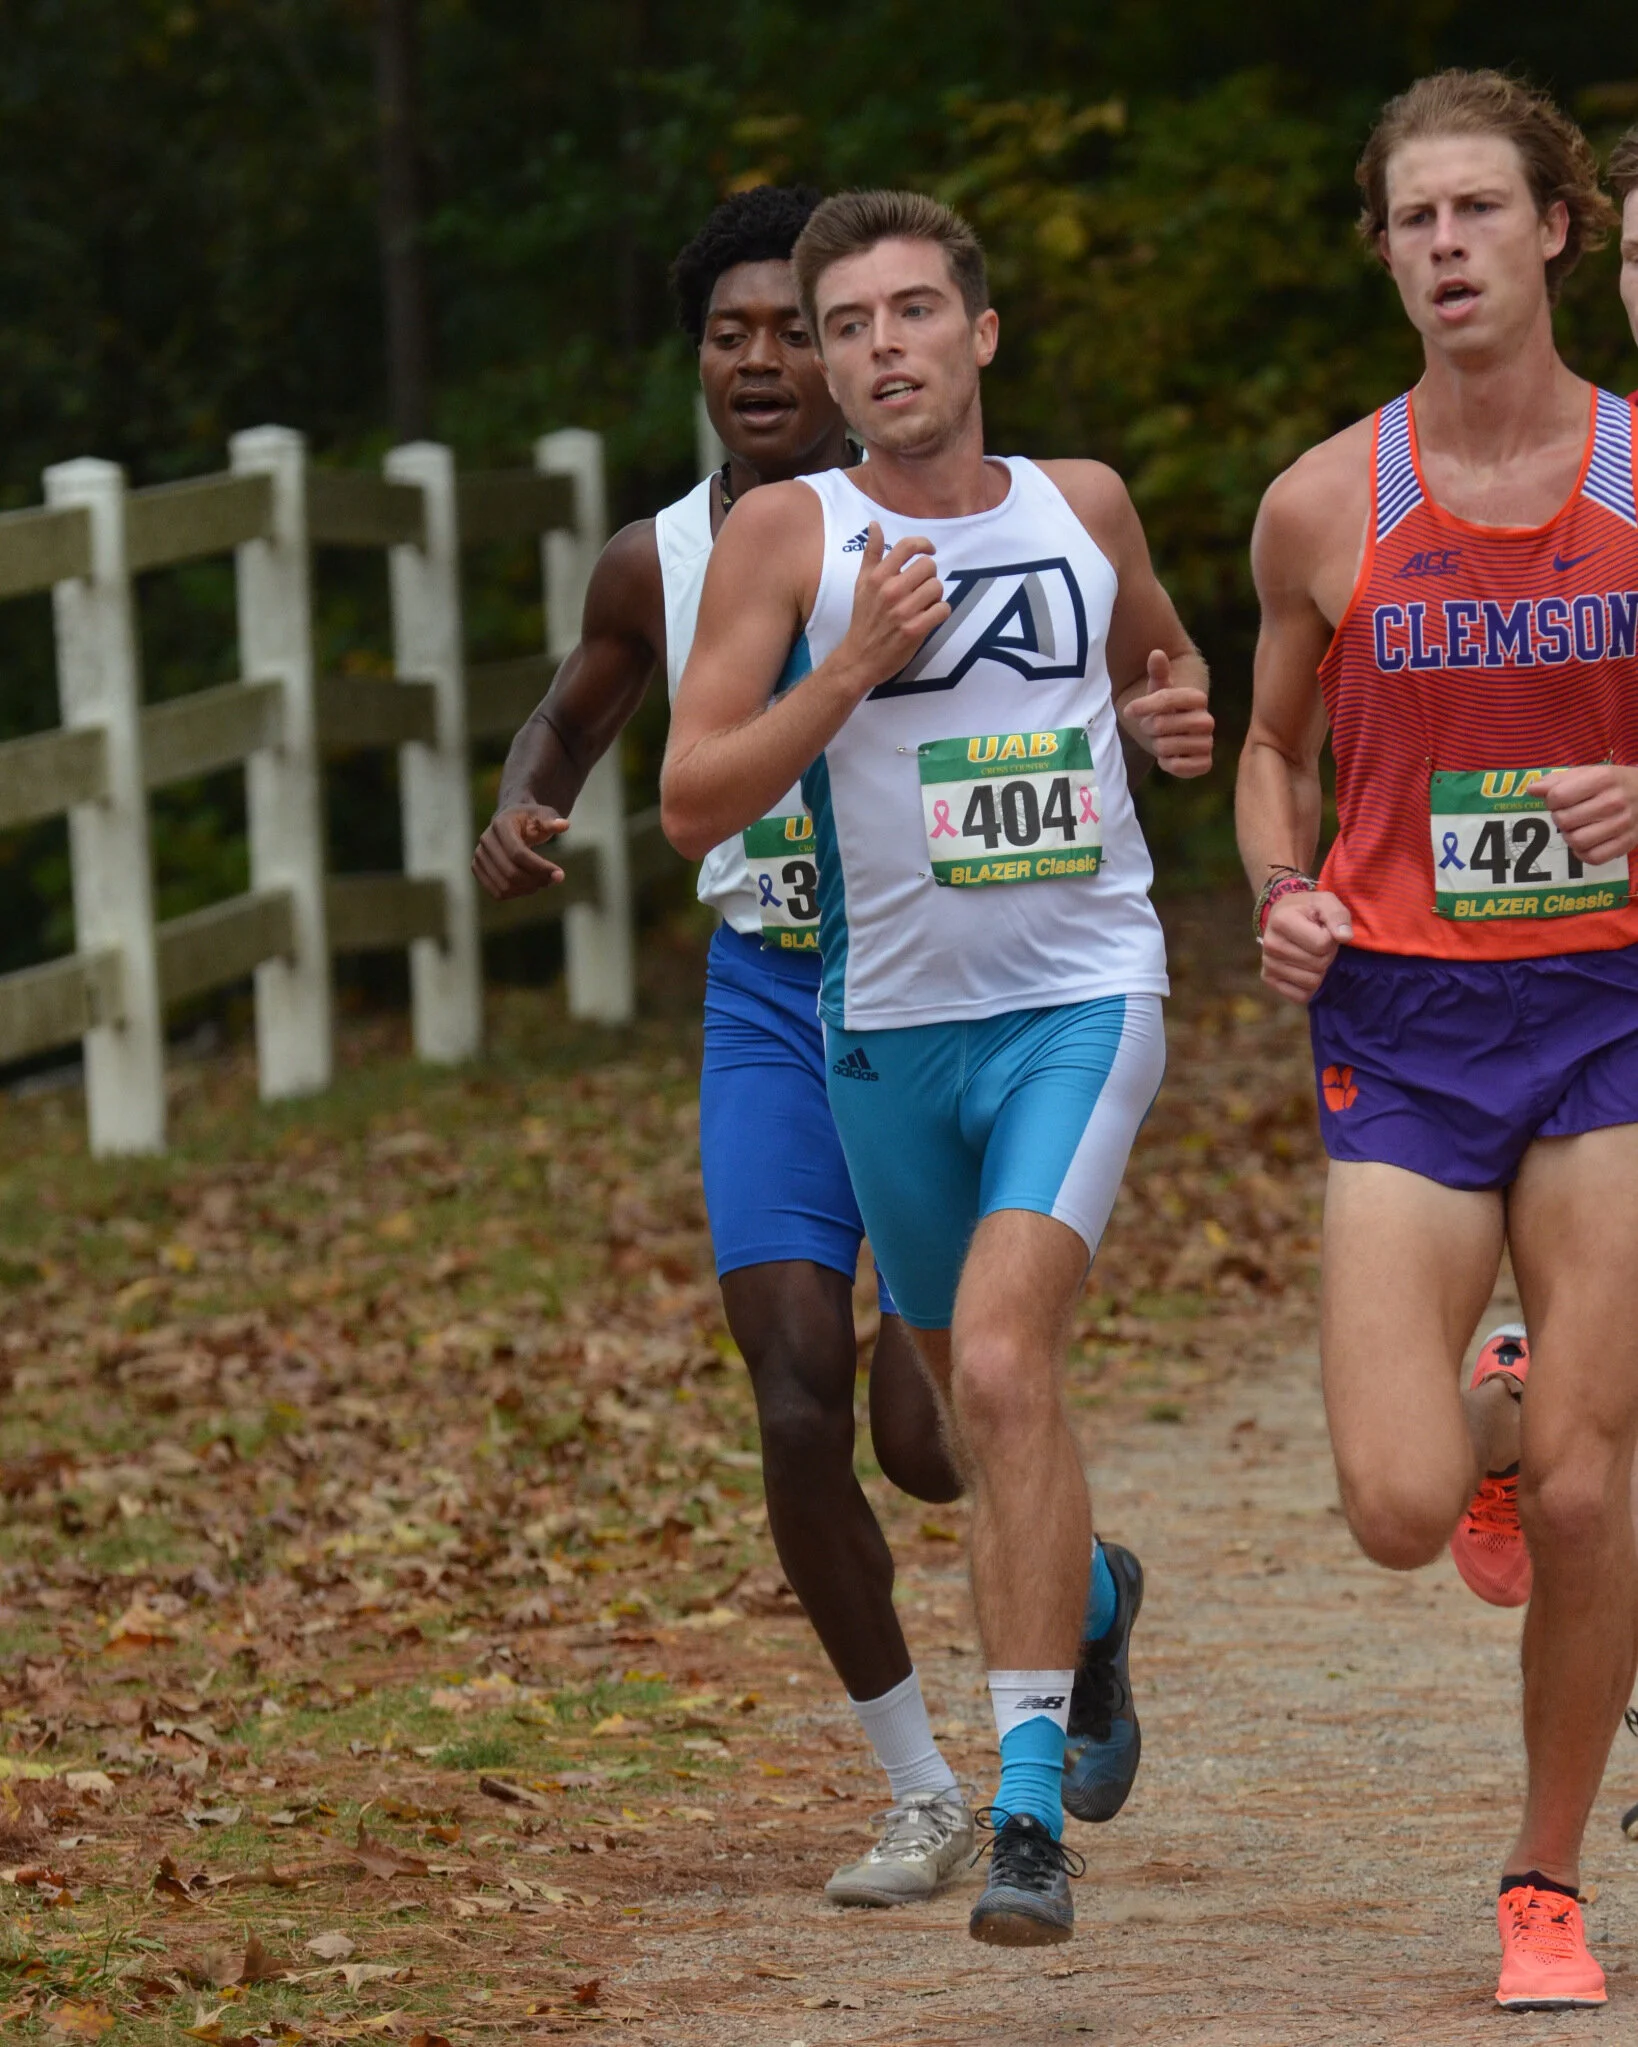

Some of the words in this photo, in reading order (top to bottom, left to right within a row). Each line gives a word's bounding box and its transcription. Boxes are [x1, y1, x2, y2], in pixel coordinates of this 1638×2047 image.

[1399, 549, 1463, 572] ACC
[1373, 591, 1638, 672] CLEMSON
[967, 732, 1059, 763] UAB
[981, 765, 1008, 775] CROSS
[1011, 761, 1050, 772] COUNTRY
[1480, 769, 1568, 798] UA
[962, 777, 1077, 849] 404
[951, 860, 1031, 885] BLAZER
[1036, 855, 1097, 876] Classic
[1454, 897, 1539, 917] BLAZER
[1543, 890, 1614, 913] Classic
[832, 1064, 880, 1082] adidas
